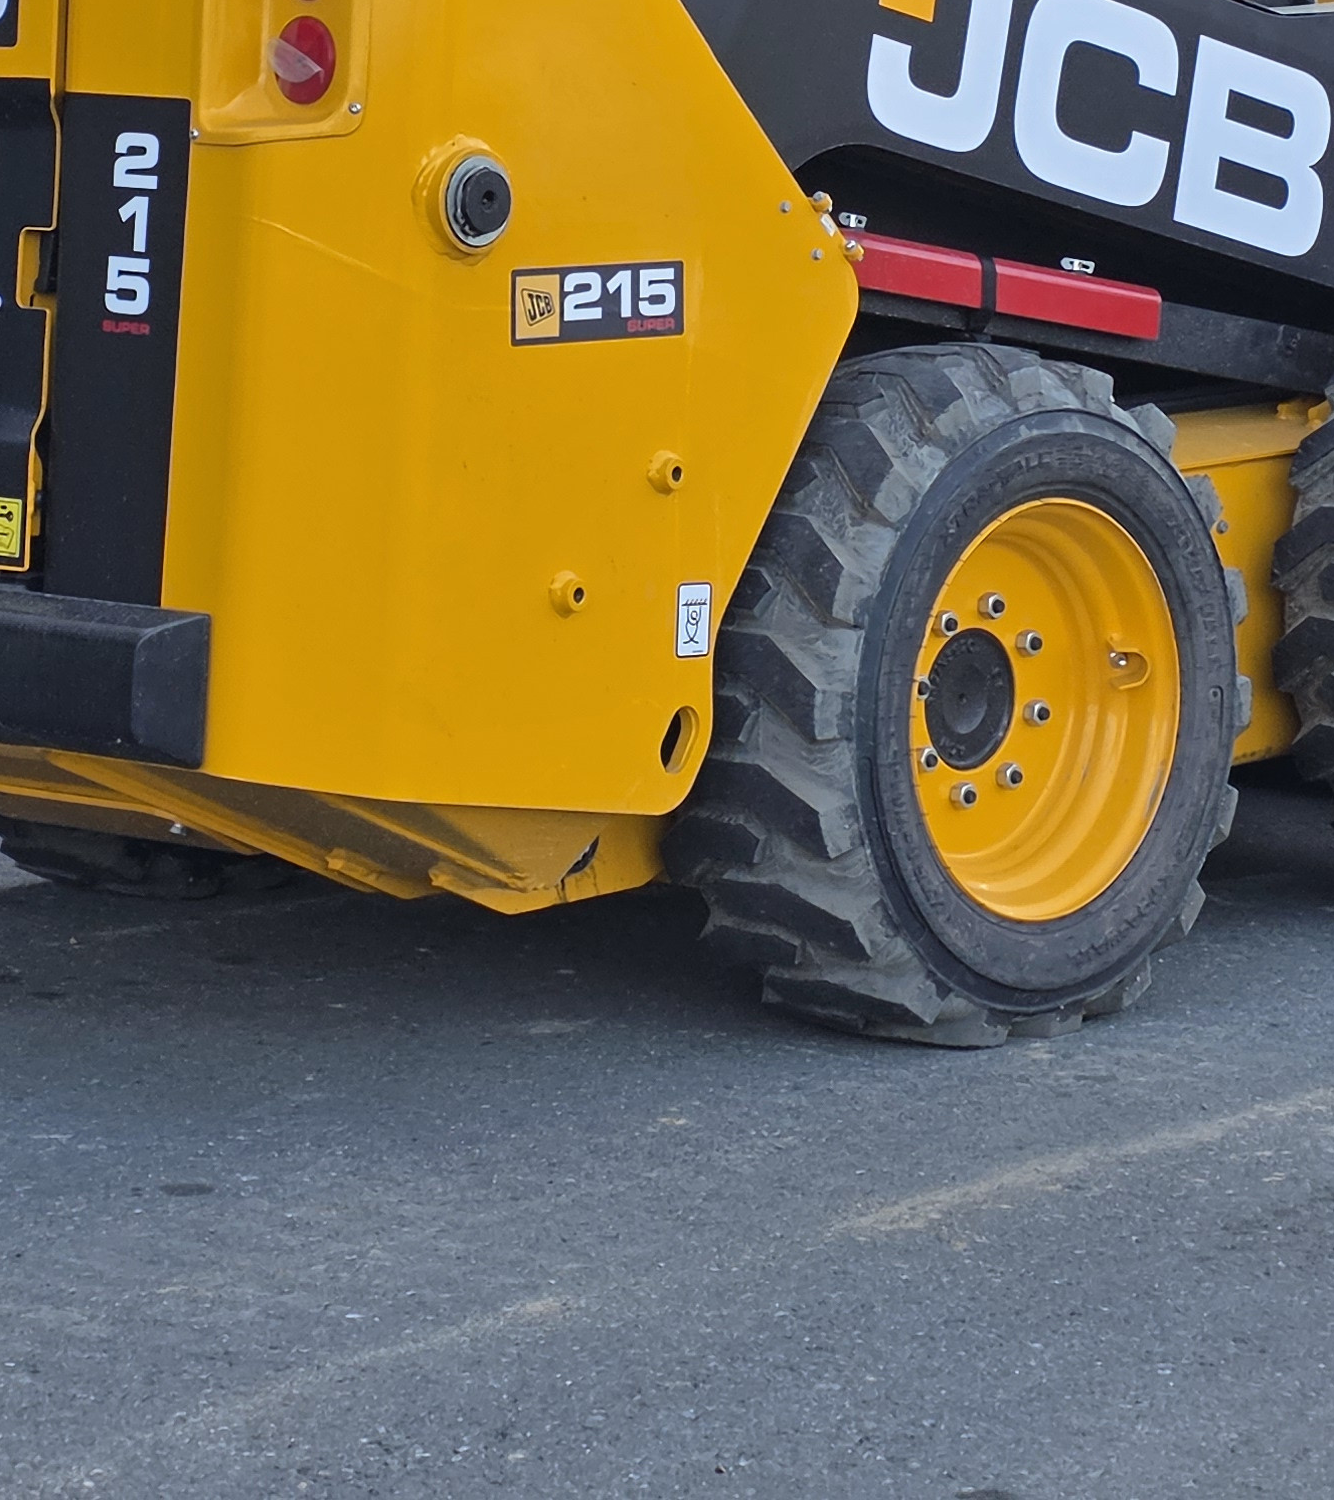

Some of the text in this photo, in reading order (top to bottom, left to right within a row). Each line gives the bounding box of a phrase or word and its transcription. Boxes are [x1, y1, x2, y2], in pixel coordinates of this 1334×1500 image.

[104, 132, 159, 315] 215
[526, 293, 553, 321] JCB
[564, 268, 675, 321] 215
[102, 320, 150, 335] SUPER
[627, 318, 675, 332] SUPER
